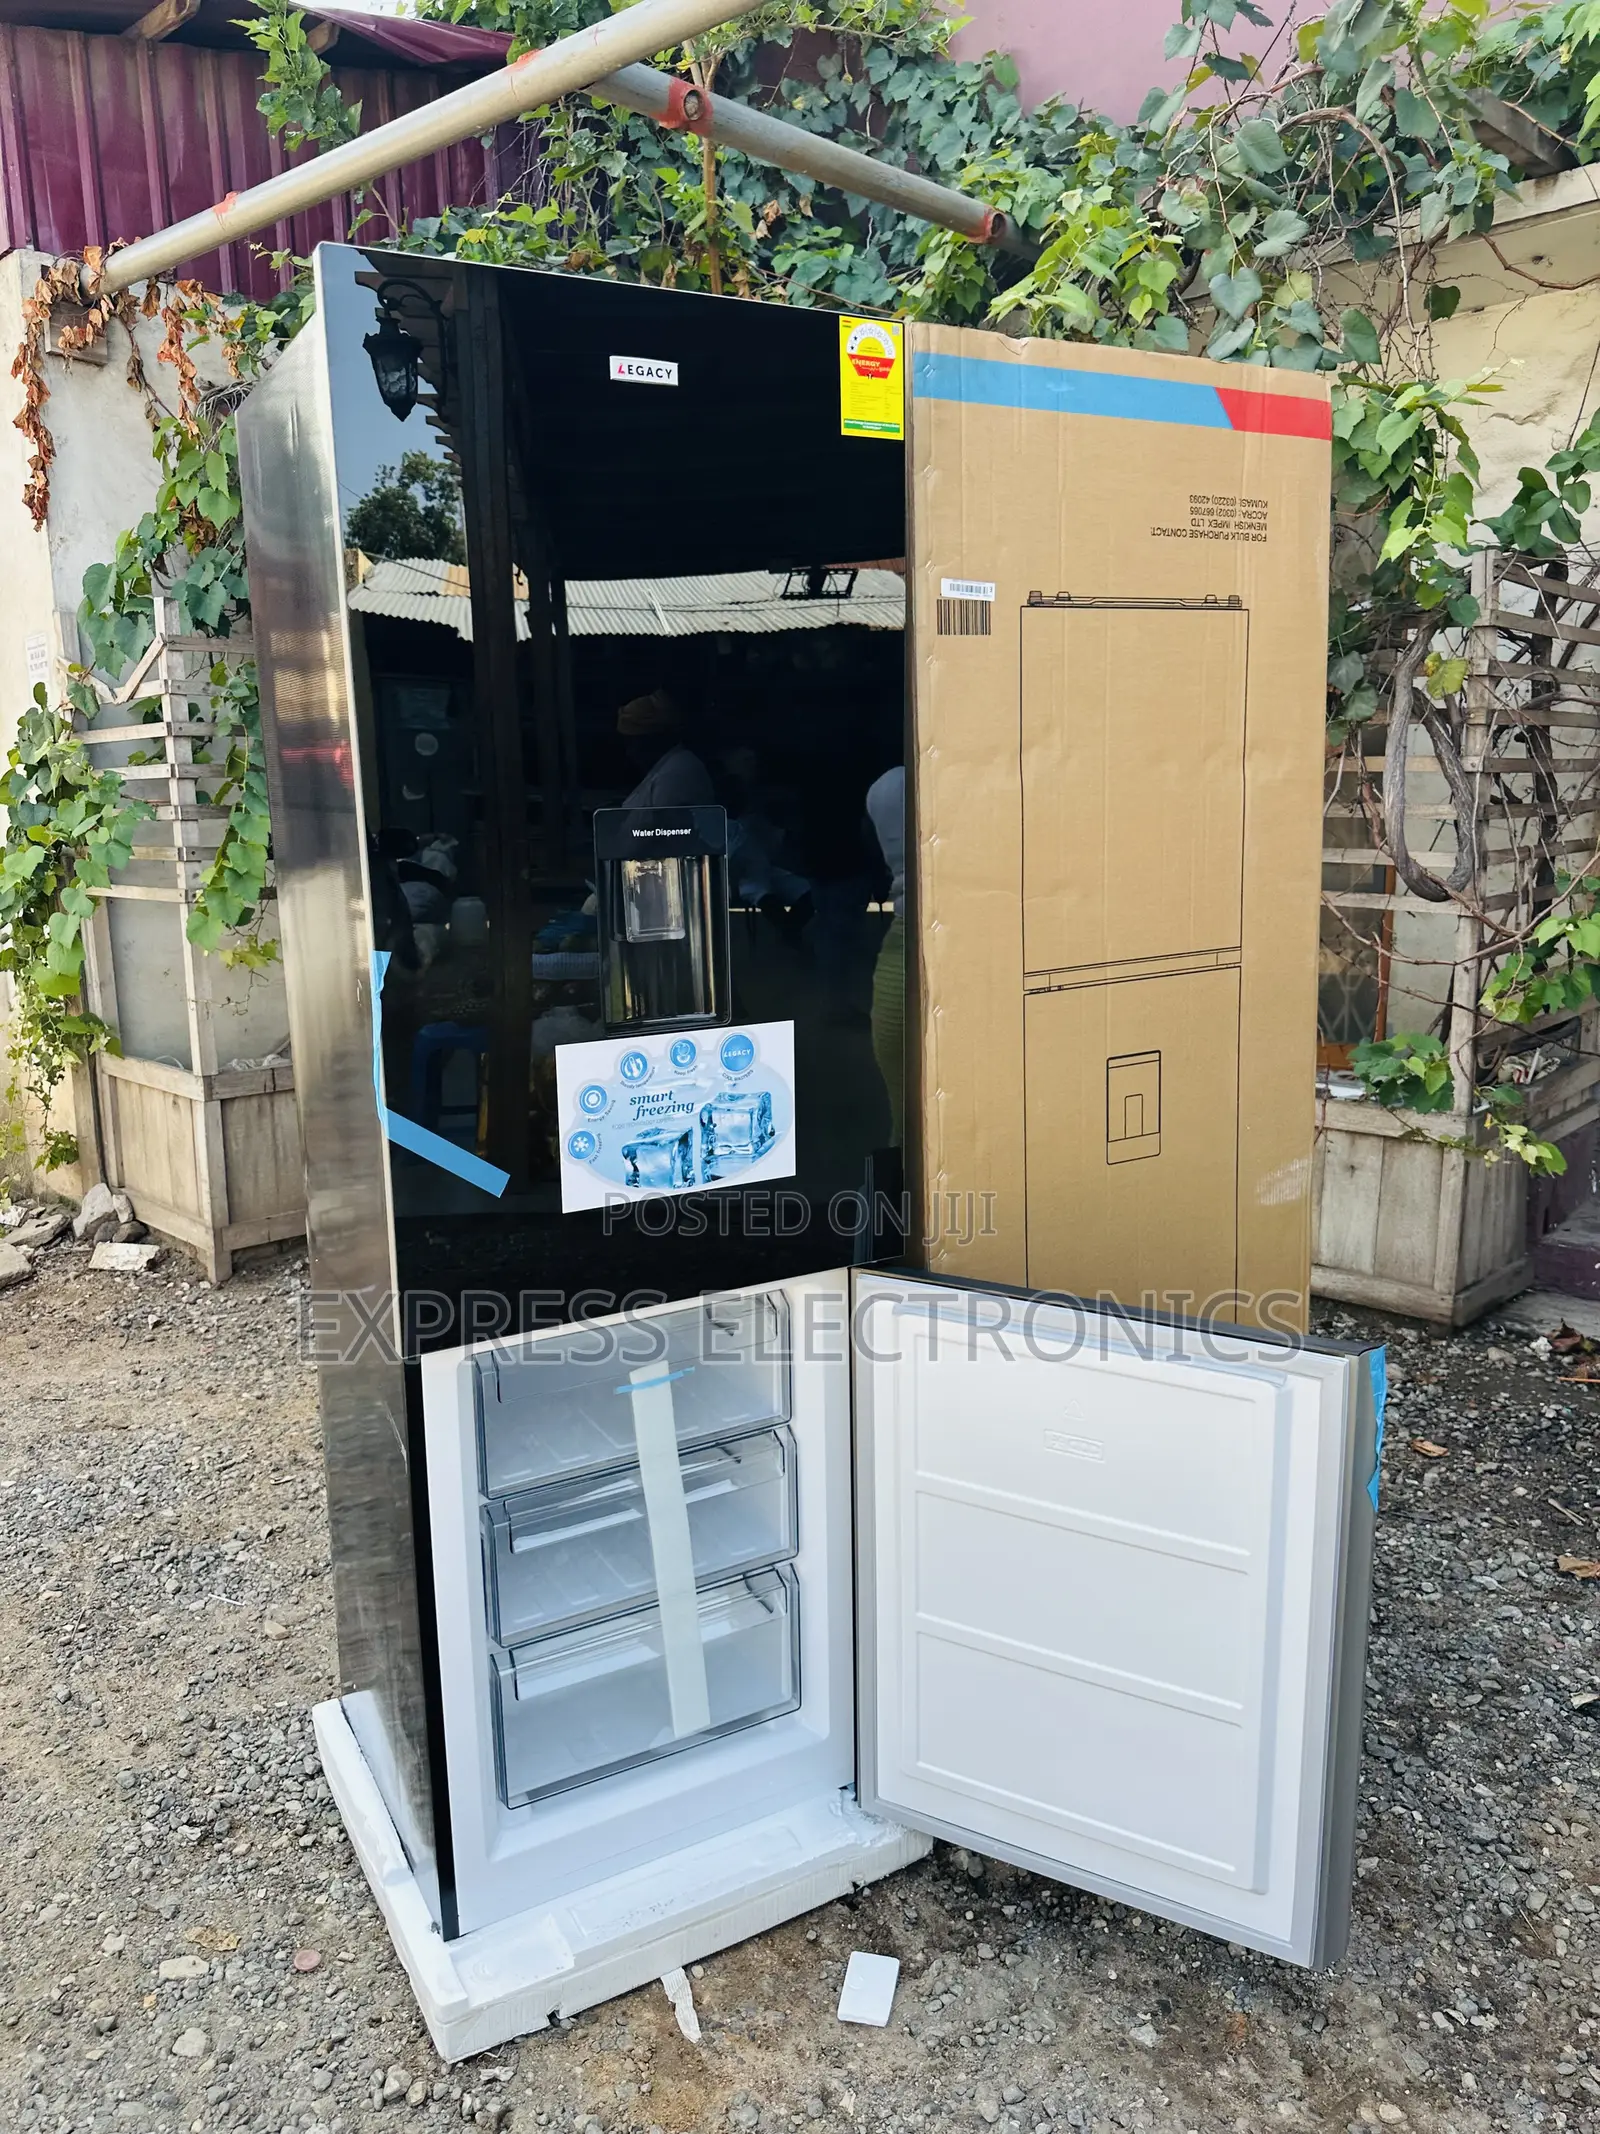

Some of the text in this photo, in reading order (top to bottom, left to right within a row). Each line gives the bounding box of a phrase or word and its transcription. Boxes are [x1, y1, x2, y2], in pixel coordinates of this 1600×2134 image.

[617, 363, 672, 379] LEGACY
[1189, 494, 1211, 505] 42093
[1211, 495, 1237, 507] (03220)
[1215, 507, 1237, 518] (0302)
[1190, 517, 1267, 531] MENKISH IMPEX LTD
[1149, 526, 1268, 542] FOR BULK PURCHASE CONTACT:
[631, 827, 692, 838] Water Dispenser
[724, 1049, 751, 1057] LEGACY
[629, 1090, 674, 1106] smart
[633, 1101, 695, 1121] freezing
[588, 1115, 605, 1123] Energy
